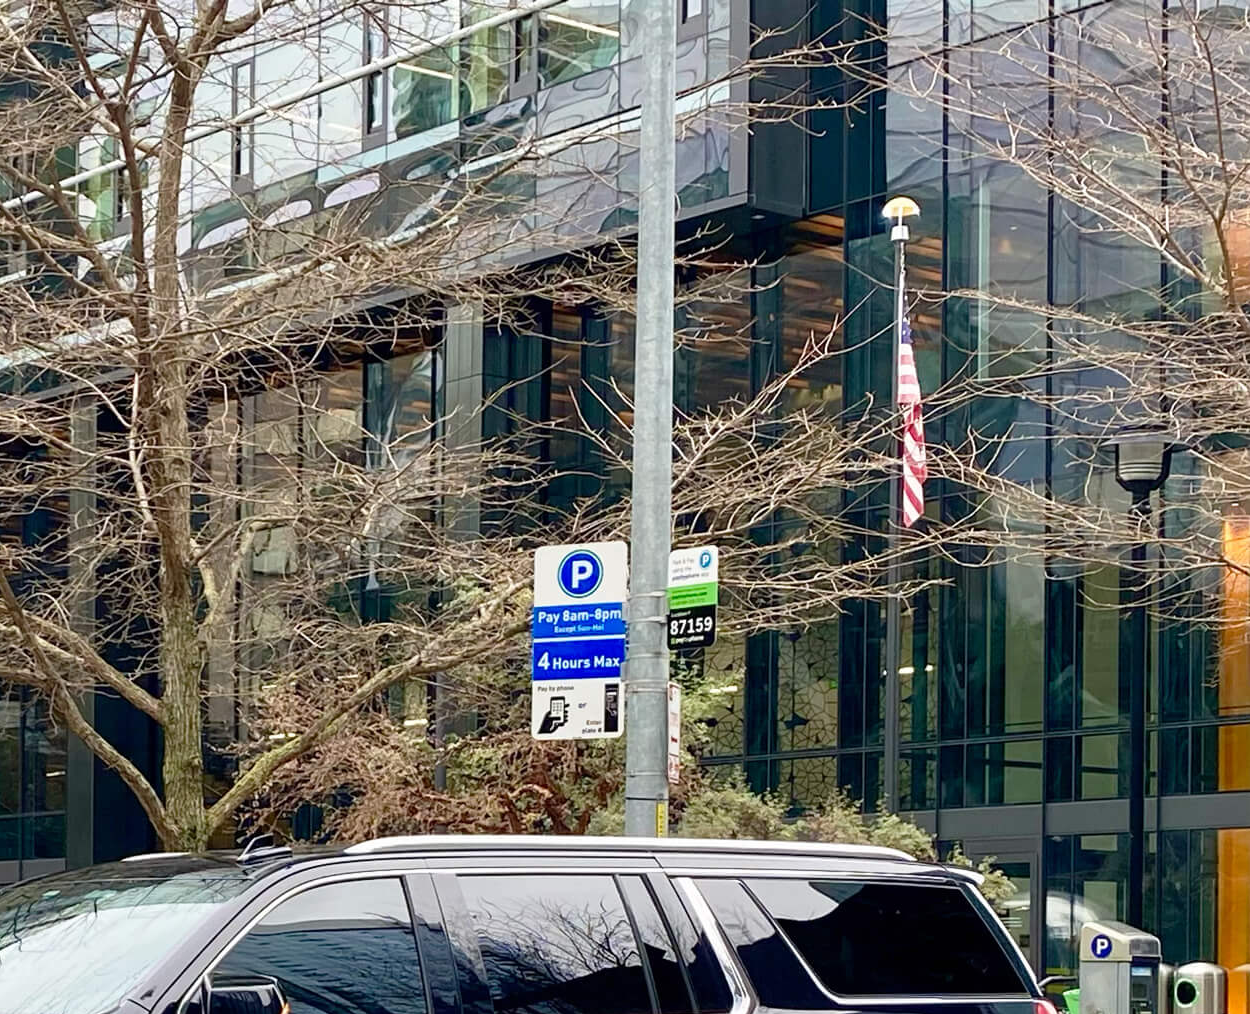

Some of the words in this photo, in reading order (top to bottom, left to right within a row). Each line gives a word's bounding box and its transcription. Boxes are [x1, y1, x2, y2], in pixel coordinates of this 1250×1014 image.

[701, 554, 711, 568] P
[571, 560, 593, 589] P
[538, 611, 560, 625] Pay
[562, 608, 622, 622] 8am-8pm
[669, 616, 713, 635] 87159
[537, 651, 550, 670] 4
[552, 656, 591, 670] Hours
[593, 655, 620, 668] Max
[1096, 938, 1109, 955] P
